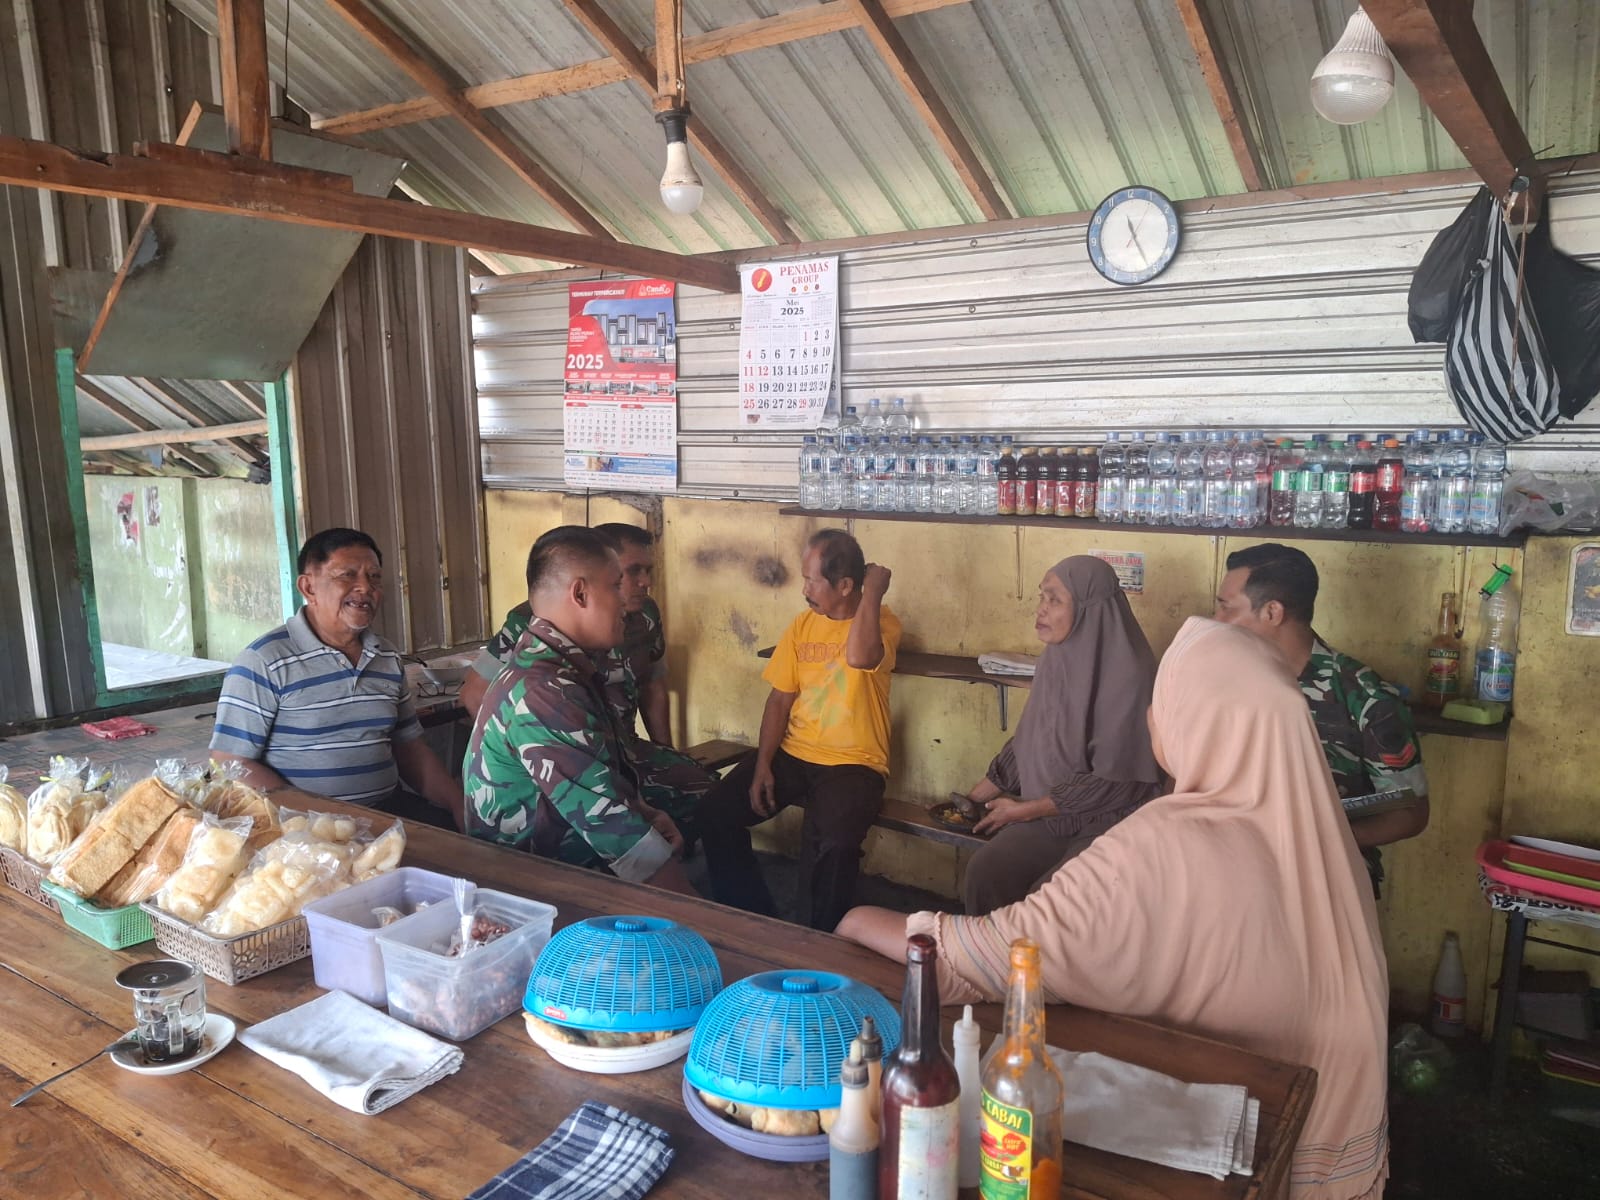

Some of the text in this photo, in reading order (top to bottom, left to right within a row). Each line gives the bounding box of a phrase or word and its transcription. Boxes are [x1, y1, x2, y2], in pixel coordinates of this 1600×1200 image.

[780, 261, 829, 276] PENAMAS
[792, 275, 819, 285] GROUP
[781, 307, 804, 315] 2025
[804, 329, 830, 341] 1 2 3
[746, 347, 830, 359] 4 5 6 7 8 9 10
[567, 354, 604, 370] 2025
[744, 363, 828, 376] 11 12 13 14 15 16 17
[744, 381, 827, 392] 18 19 20 21 22 23 24
[743, 398, 825, 408] 25 26 27 28 29 30 31
[986, 1100, 1022, 1129] CABAI
